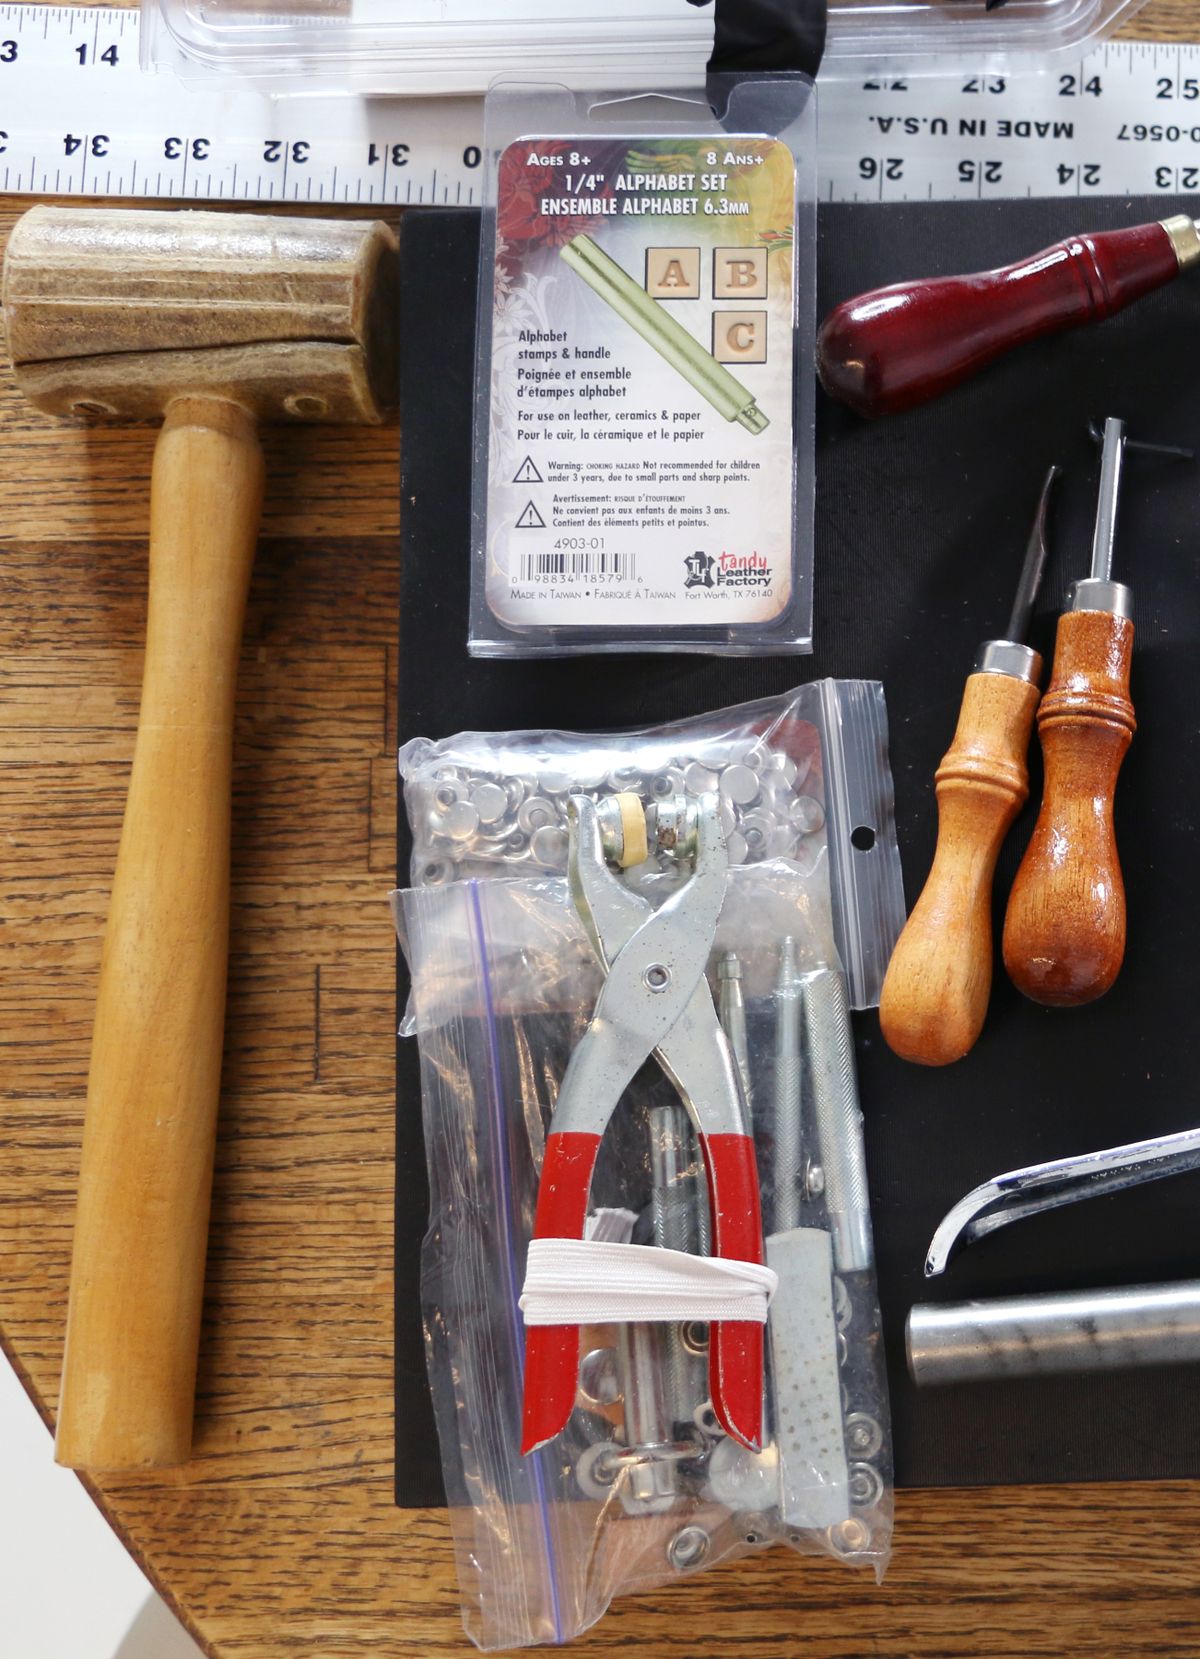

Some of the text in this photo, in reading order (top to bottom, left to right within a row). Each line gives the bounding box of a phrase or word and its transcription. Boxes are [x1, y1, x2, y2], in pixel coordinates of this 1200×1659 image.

[76, 43, 118, 66] 14
[1059, 75, 1102, 97] 24
[1157, 78, 1199, 100] 25
[869, 116, 1074, 139] MADE IN U.S.A.
[64, 134, 109, 157] 34
[165, 137, 210, 159] 33
[264, 140, 310, 163] 32
[369, 143, 410, 166] 31
[526, 152, 591, 166] AGES 8+
[706, 152, 717, 165] 8
[860, 158, 903, 180] 26
[959, 160, 1002, 182] 25
[1057, 163, 1100, 185] 24
[1155, 166, 1199, 188] 23
[565, 174, 728, 194] 1/4" ALPHABET SET
[541, 198, 617, 215] ENSEMBLE
[622, 198, 698, 215] ALPHABET
[657, 259, 758, 288] A B
[518, 329, 567, 345] Alphabet
[726, 322, 755, 353] C
[518, 346, 611, 362] stamps & handle
[517, 367, 632, 383] Poignée et ensemble
[579, 384, 626, 400] alphabet
[518, 409, 701, 423] For use on leather, ceramics & paper
[517, 428, 705, 442] Pour le cuir, la céramique et le papier
[548, 461, 583, 472] Warning:
[643, 461, 657, 469] Not
[660, 460, 713, 469] recommended
[716, 461, 727, 469] for
[730, 460, 761, 469] children
[548, 472, 750, 483] under 3 years, due to small parts and sharp points.
[553, 494, 611, 502] Avertissement:
[553, 506, 563, 514] Ne
[567, 506, 598, 514] convient
[602, 507, 615, 516] pas
[636, 505, 665, 514] enfants
[668, 505, 677, 514] de
[680, 506, 703, 514] moins
[706, 506, 711, 514] 3
[553, 517, 709, 528] Contient des éléments petits et pointus.
[554, 537, 605, 550] 4903-01
[719, 551, 767, 571] tandy
[534, 574, 574, 584] 98834
[583, 574, 623, 584] 18579
[637, 576, 644, 584] 6
[717, 567, 773, 577] Leather
[717, 577, 772, 587] Factory
[511, 589, 535, 599] MADE
[550, 589, 582, 599] TAIWAN
[645, 589, 676, 599] TAIWAN
[703, 591, 730, 599] Worth,
[746, 589, 773, 598] 76140
